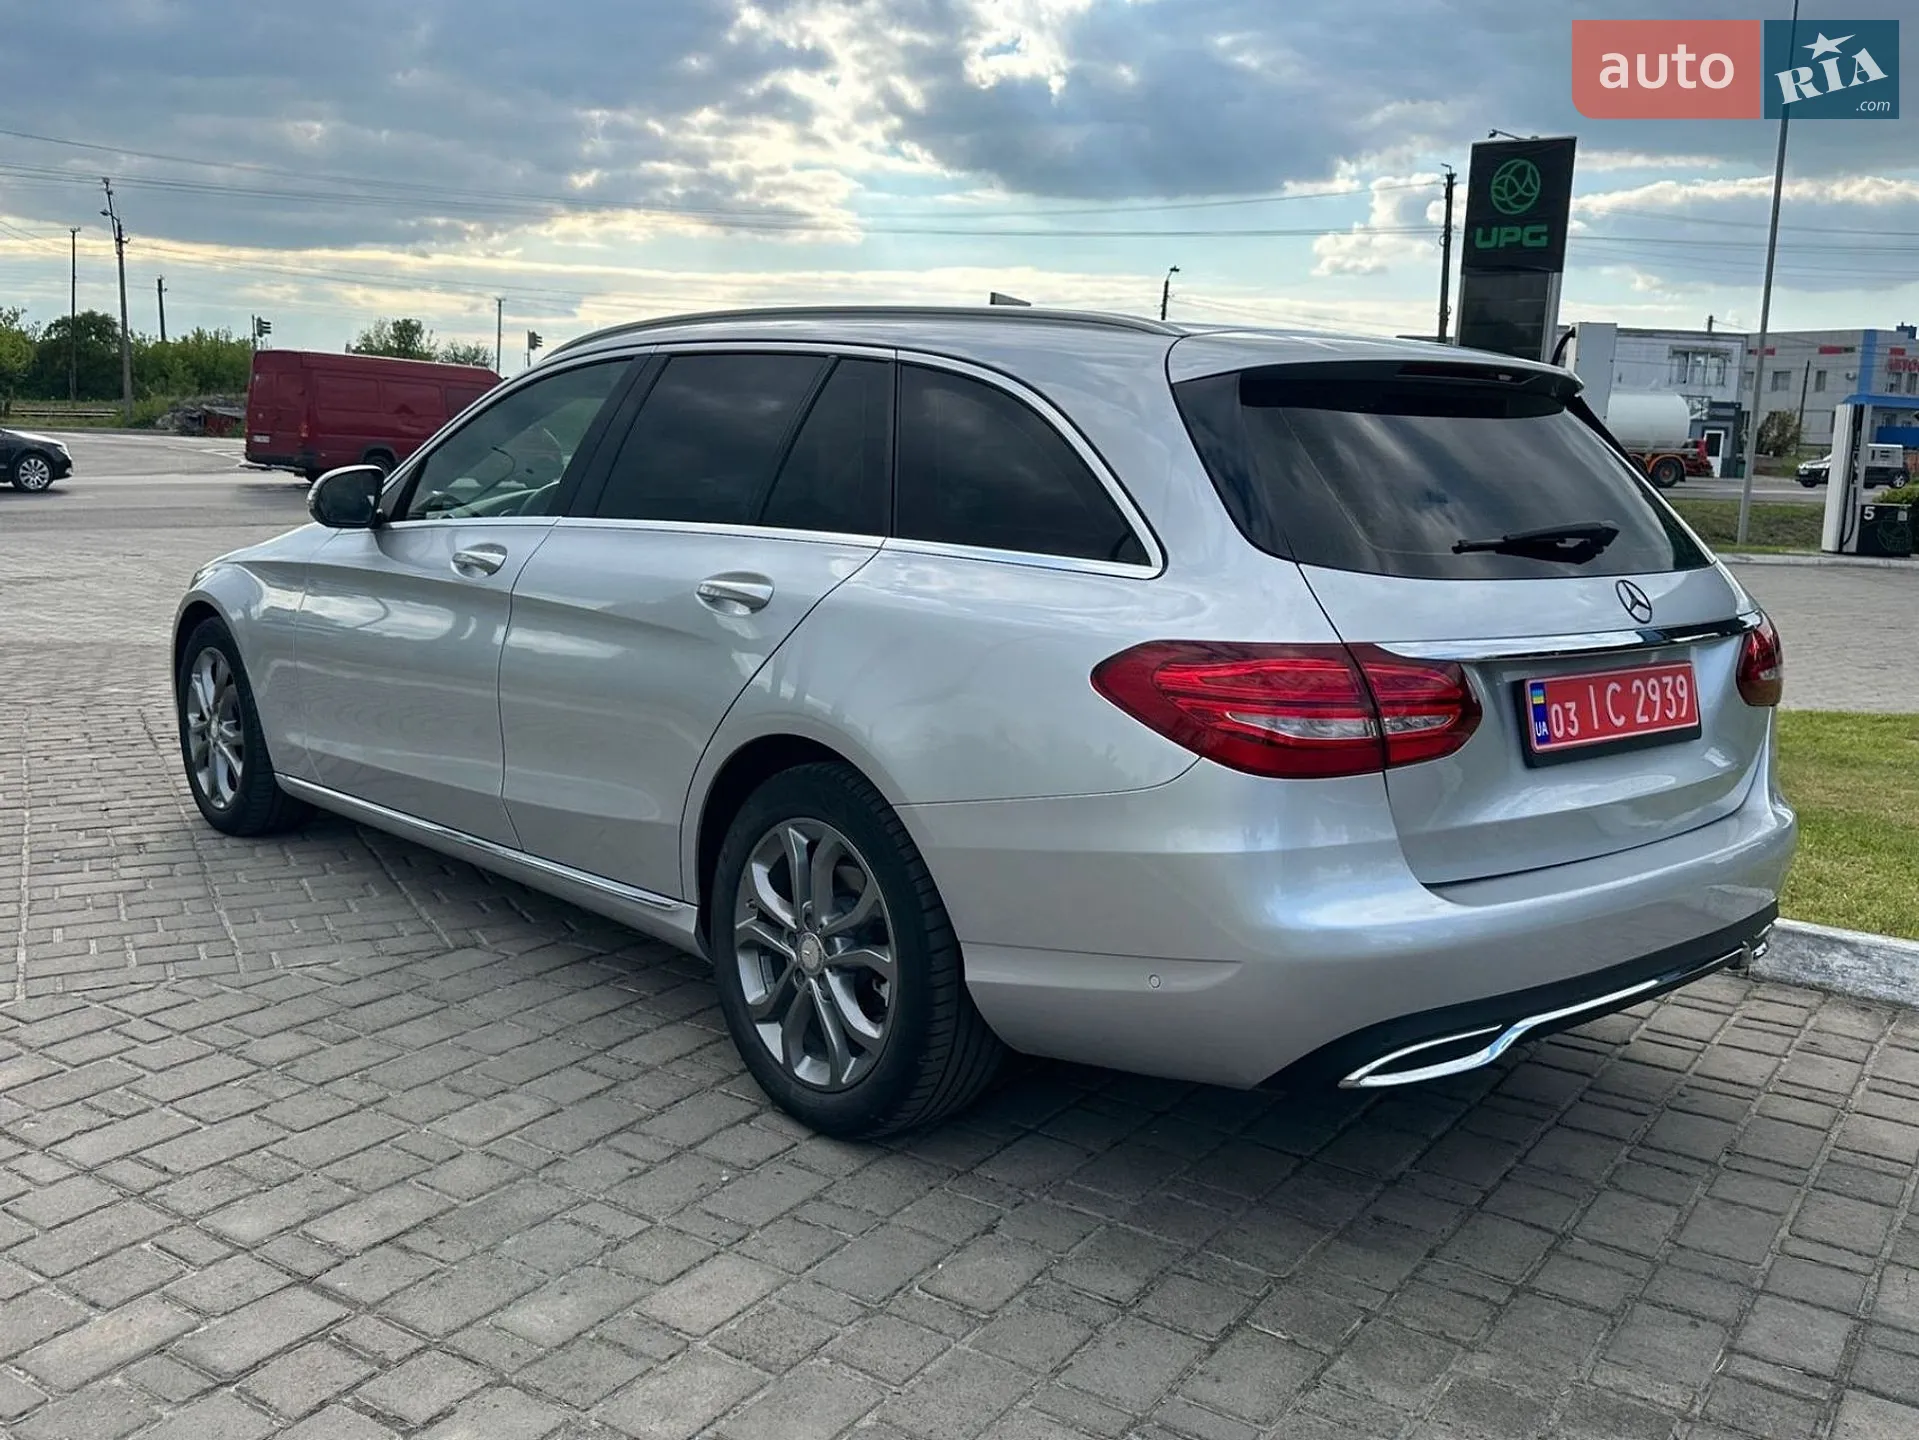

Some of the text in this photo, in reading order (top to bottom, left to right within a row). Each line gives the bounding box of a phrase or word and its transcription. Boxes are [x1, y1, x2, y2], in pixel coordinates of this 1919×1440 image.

[1475, 224, 1548, 249] UPG
[1863, 506, 1876, 520] 5
[1551, 702, 1579, 739] 03
[1632, 674, 1688, 724] 2939
[1535, 721, 1549, 737] UA
